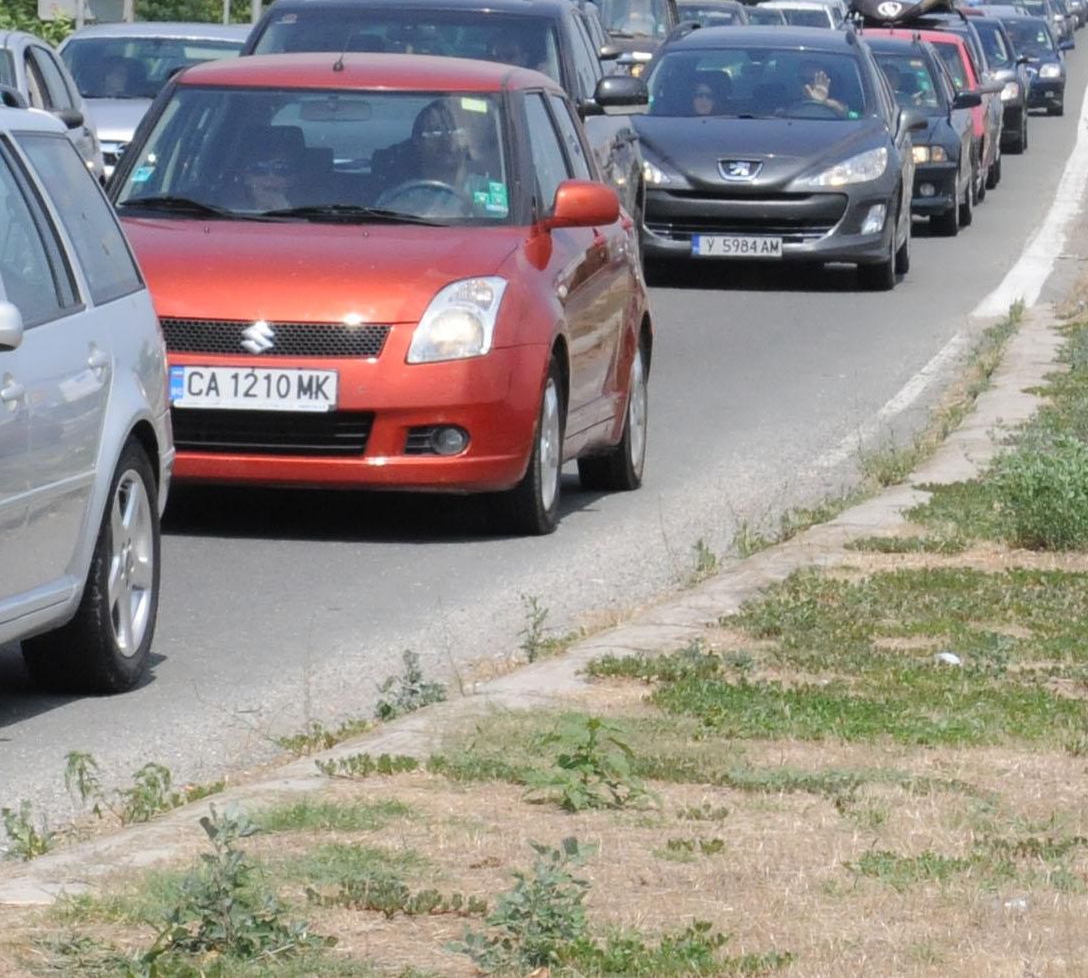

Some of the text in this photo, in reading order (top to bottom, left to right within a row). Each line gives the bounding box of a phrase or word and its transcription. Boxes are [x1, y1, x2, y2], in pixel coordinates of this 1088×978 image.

[761, 239, 780, 254] AM
[187, 371, 331, 401] CA 1210 MK
